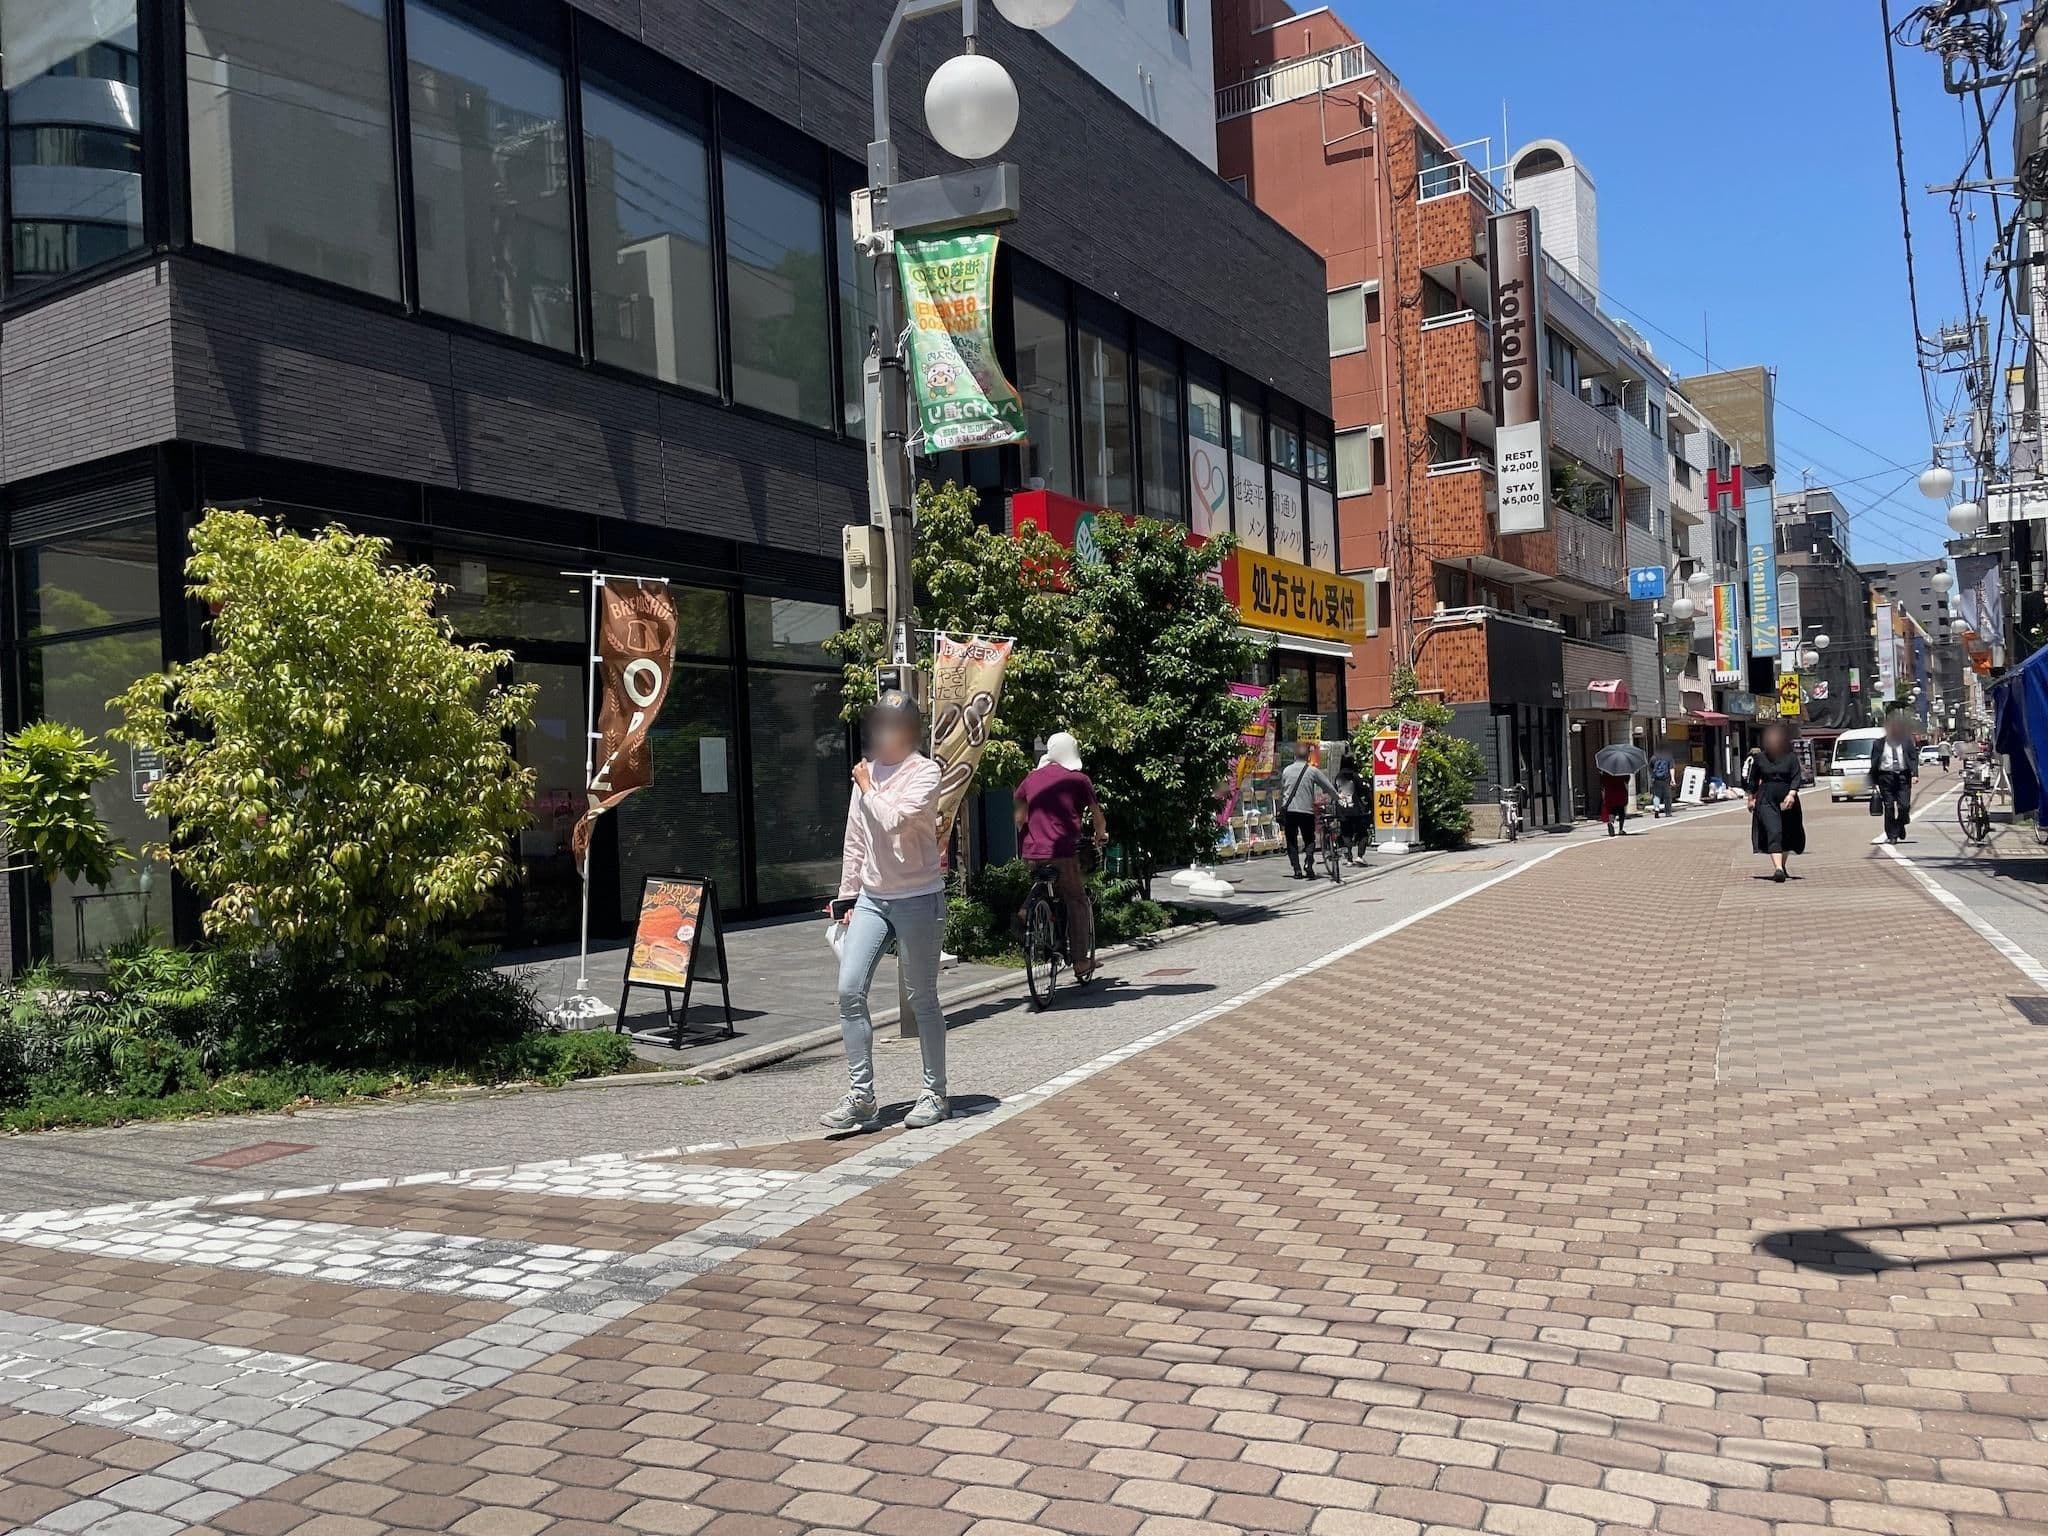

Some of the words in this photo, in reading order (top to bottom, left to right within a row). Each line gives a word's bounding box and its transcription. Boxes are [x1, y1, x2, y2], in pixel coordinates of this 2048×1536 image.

[1515, 219, 1529, 262] HOTEL
[1500, 278, 1528, 391] totolo
[1501, 461, 1539, 473] ¥2,000
[1505, 450, 1533, 461] REST
[1502, 494, 1540, 505] ¥5,000
[1506, 483, 1535, 493] STAY
[1707, 465, 1743, 513] H
[1252, 562, 1354, 631] 処方せん受付
[1751, 546, 1770, 624] cleaning
[894, 627, 905, 664] 平和通
[1753, 625, 1777, 651] 24
[943, 644, 1002, 662] BAKERY
[1375, 740, 1399, 770] くす
[1379, 810, 1411, 824] せん
